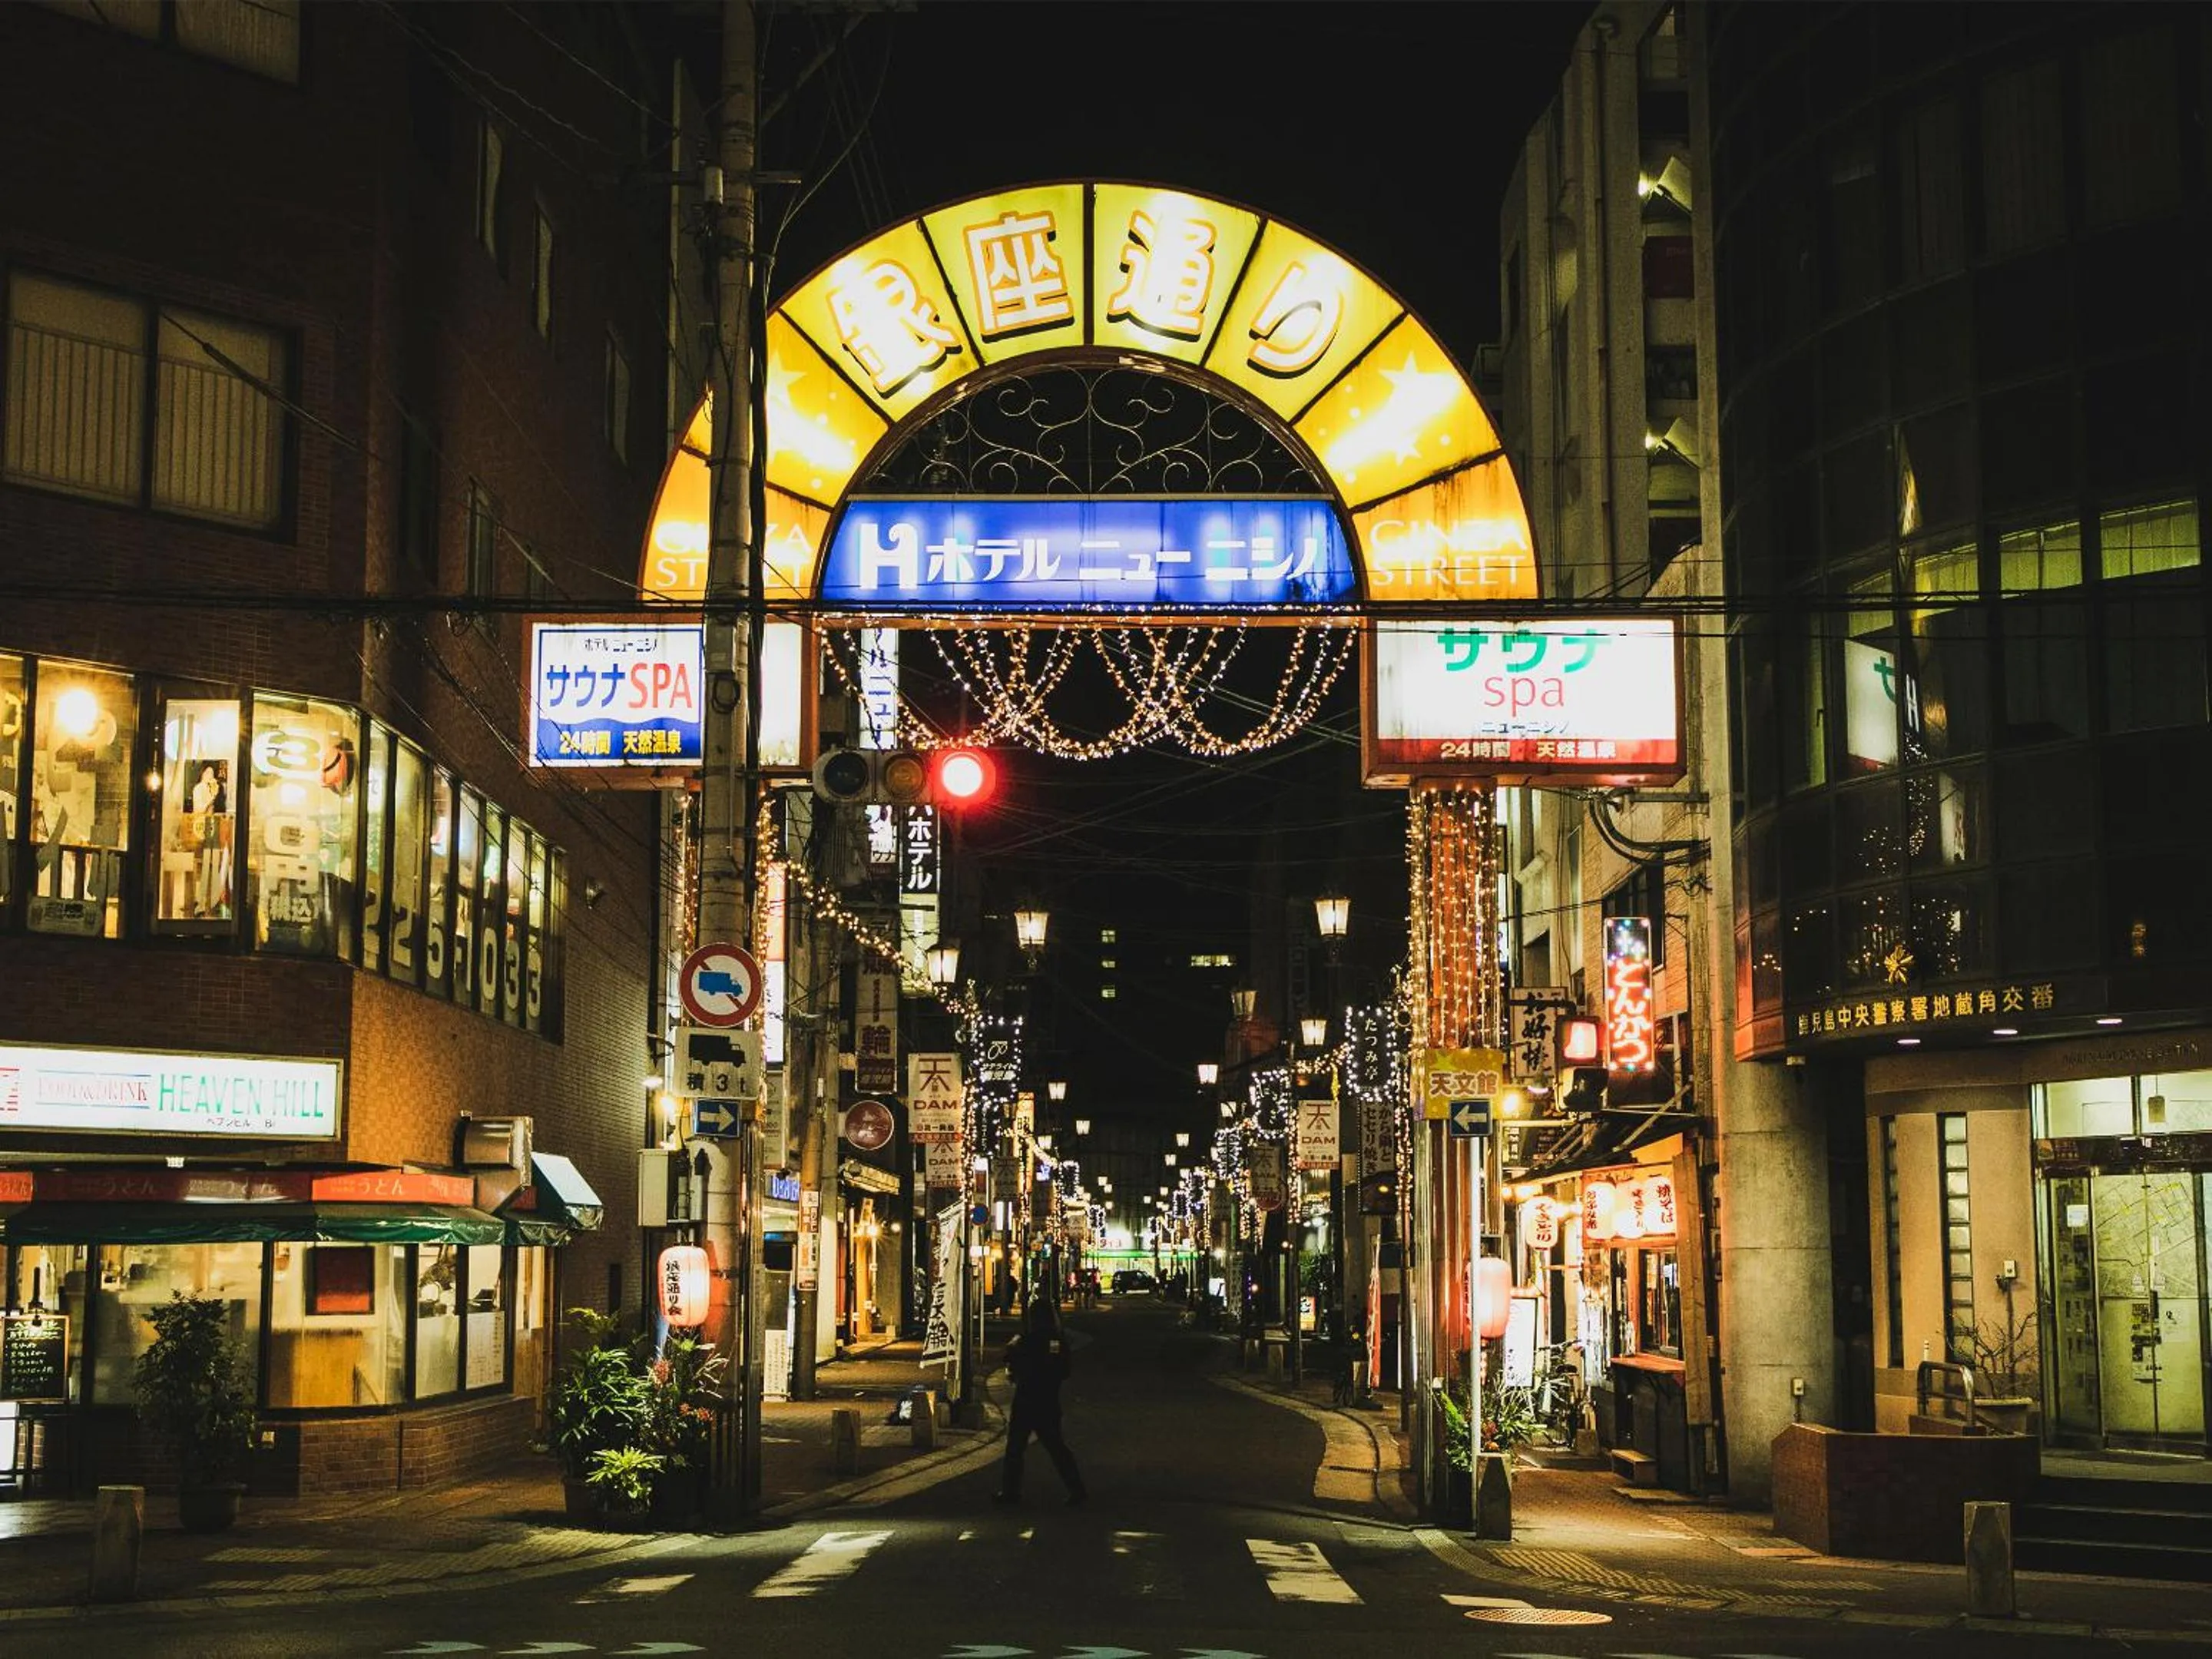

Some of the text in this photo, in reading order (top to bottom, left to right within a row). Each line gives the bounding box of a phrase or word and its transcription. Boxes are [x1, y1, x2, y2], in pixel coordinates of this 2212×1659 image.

[826, 209, 1346, 395] 銀座通り
[656, 521, 812, 555] GIZA
[1370, 519, 1528, 551] GINZA
[656, 558, 810, 587] STET
[926, 538, 1061, 581] ホテル
[1079, 540, 1191, 581] ニュー
[1204, 537, 1320, 581] ニシノ
[1373, 555, 1526, 586] STREET
[1437, 628, 1612, 673] サウナ
[1483, 677, 1565, 717] spa
[559, 730, 682, 755] 24時間 天然温泉
[1440, 741, 1617, 759] 24時間 天然温泉
[1613, 959, 1651, 1064] とんかつ
[1798, 983, 2054, 1036] 鹿児島中央警察署地蔵角交番
[159, 1074, 323, 1118] HEAVEN HILL
[1429, 1071, 1498, 1096] 天文館
[913, 1100, 958, 1111] DAM
[1302, 1136, 1336, 1145] DAM
[357, 1177, 405, 1197] うどん
